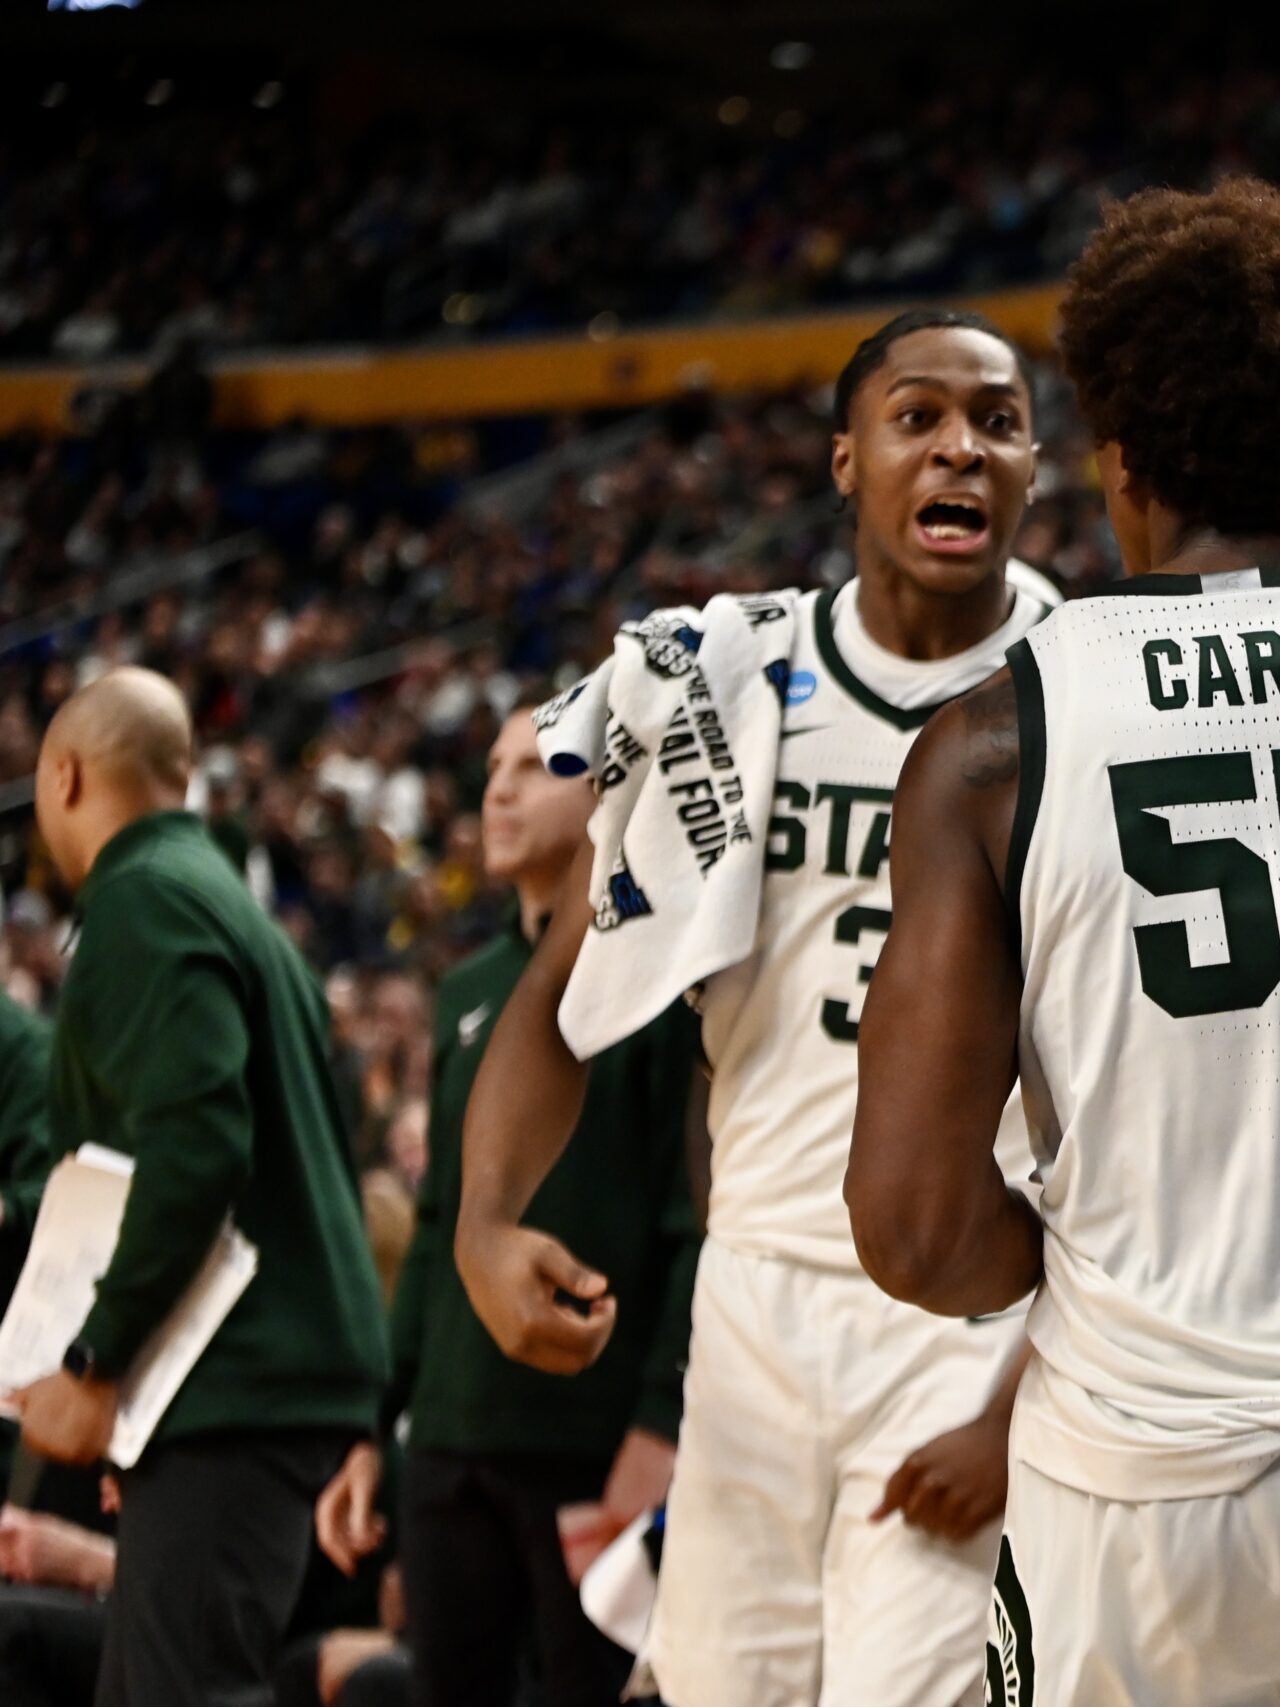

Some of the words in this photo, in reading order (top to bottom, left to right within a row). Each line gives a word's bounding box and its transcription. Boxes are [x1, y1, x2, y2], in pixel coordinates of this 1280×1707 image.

[694, 708, 735, 771] ROAD
[719, 775, 744, 804] TO
[667, 778, 728, 880] FOUR
[764, 780, 897, 879] STA
